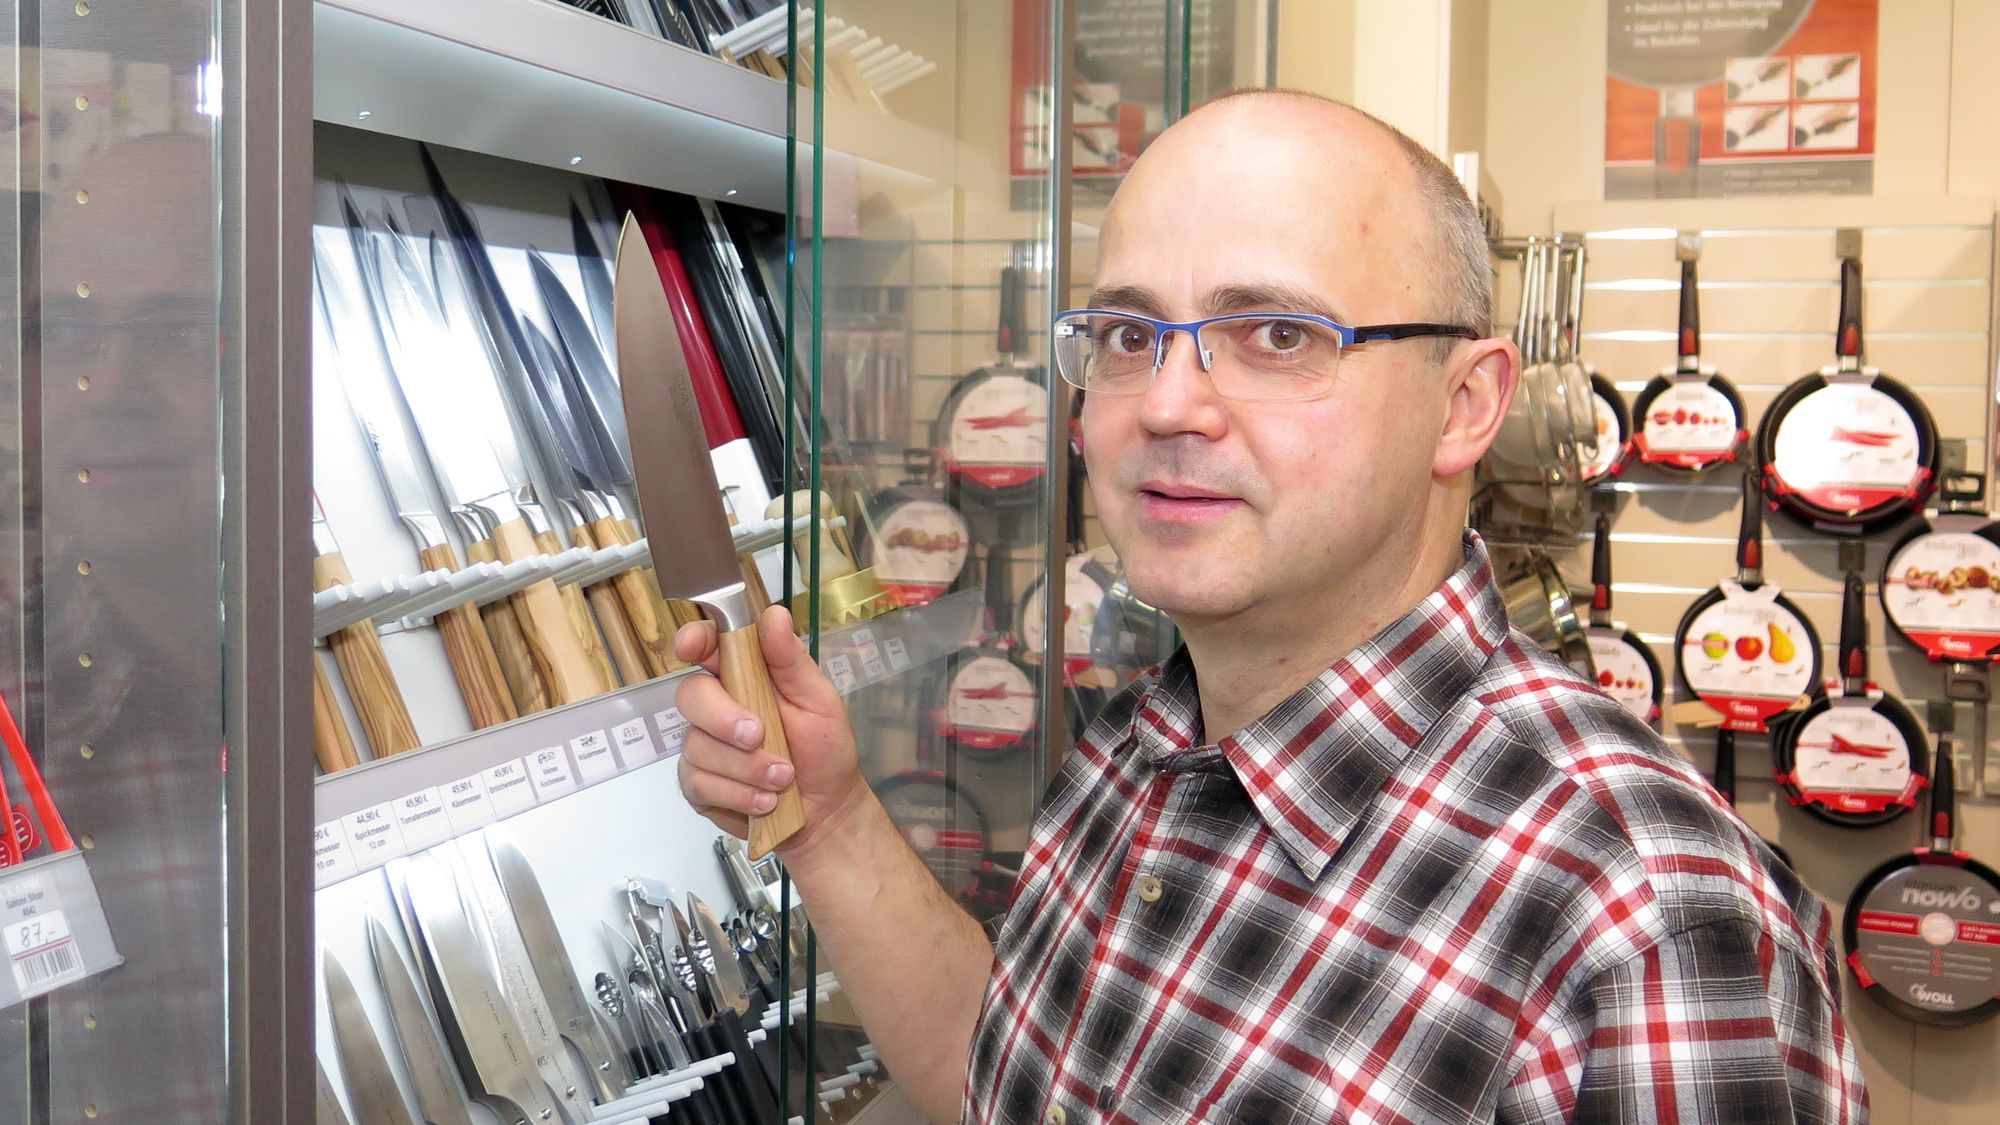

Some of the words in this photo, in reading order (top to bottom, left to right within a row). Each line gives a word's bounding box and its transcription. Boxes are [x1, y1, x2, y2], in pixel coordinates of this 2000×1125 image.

[489, 776, 526, 794] Brötchenmesser
[451, 794, 482, 808] Käsemesser
[356, 811, 375, 824] 44,90
[400, 805, 442, 825] Tomatenmesser
[355, 823, 391, 841] Spickmesser
[369, 841, 377, 850] 12
[316, 861, 325, 870] 10
[325, 858, 336, 867] cm
[1919, 989, 1954, 1005] WOLL
